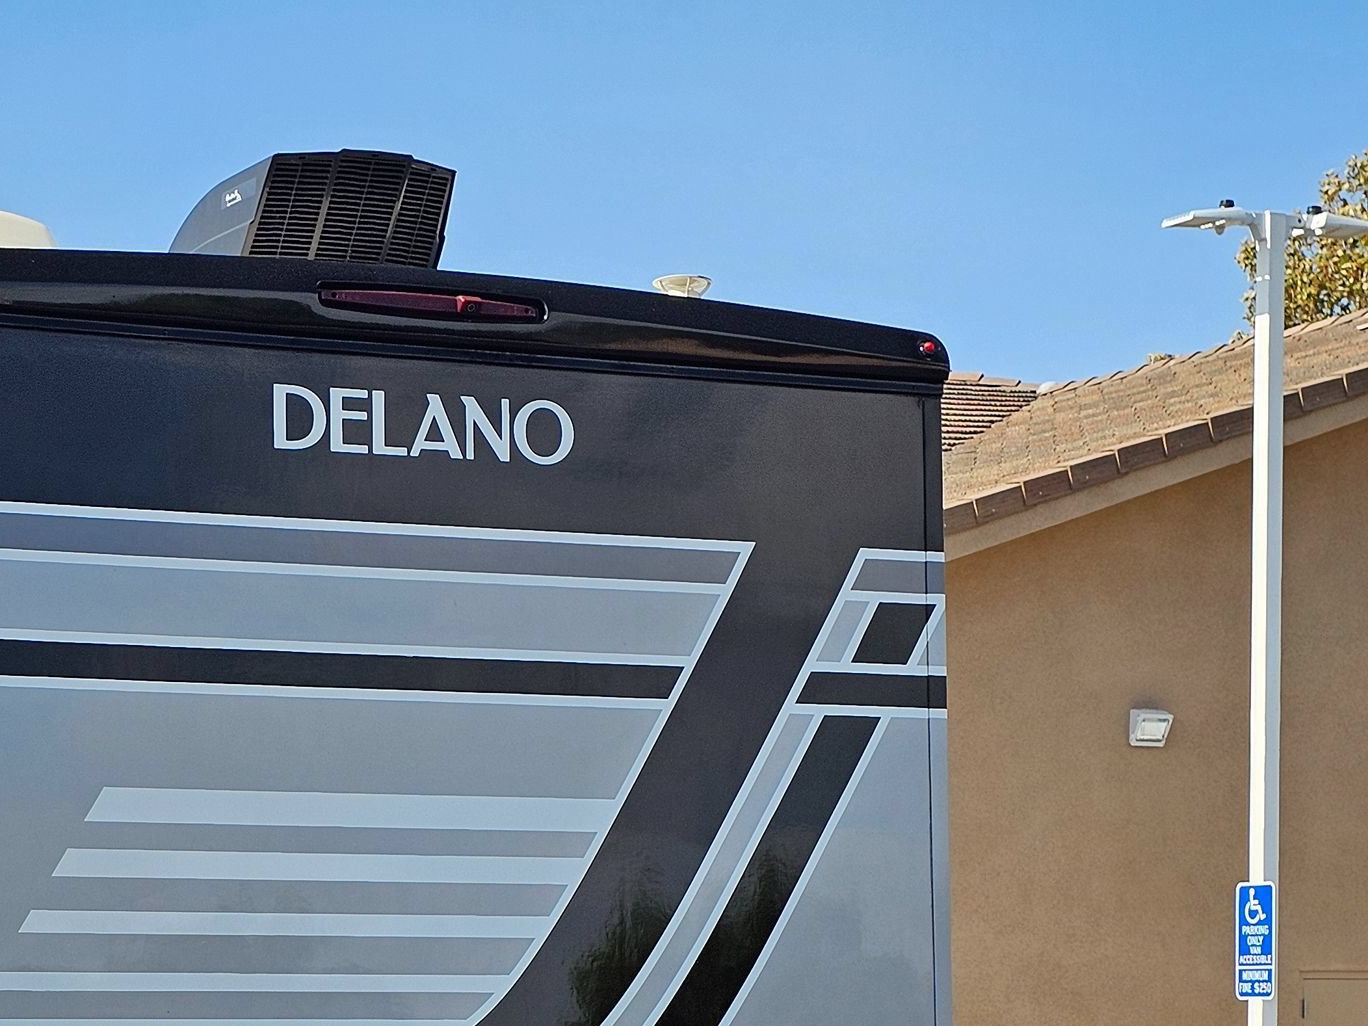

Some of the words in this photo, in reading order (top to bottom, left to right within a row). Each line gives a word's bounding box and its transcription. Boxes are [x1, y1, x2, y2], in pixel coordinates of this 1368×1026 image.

[272, 382, 575, 466] DELANO
[1241, 925, 1269, 935] PARKING
[1247, 936, 1263, 945] ONLY
[1250, 946, 1261, 954] VAN
[1239, 955, 1271, 964] ACCESSIBLE
[1242, 971, 1268, 980] MINIMUM
[1239, 982, 1252, 993] FINE
[1254, 982, 1271, 993] $250
